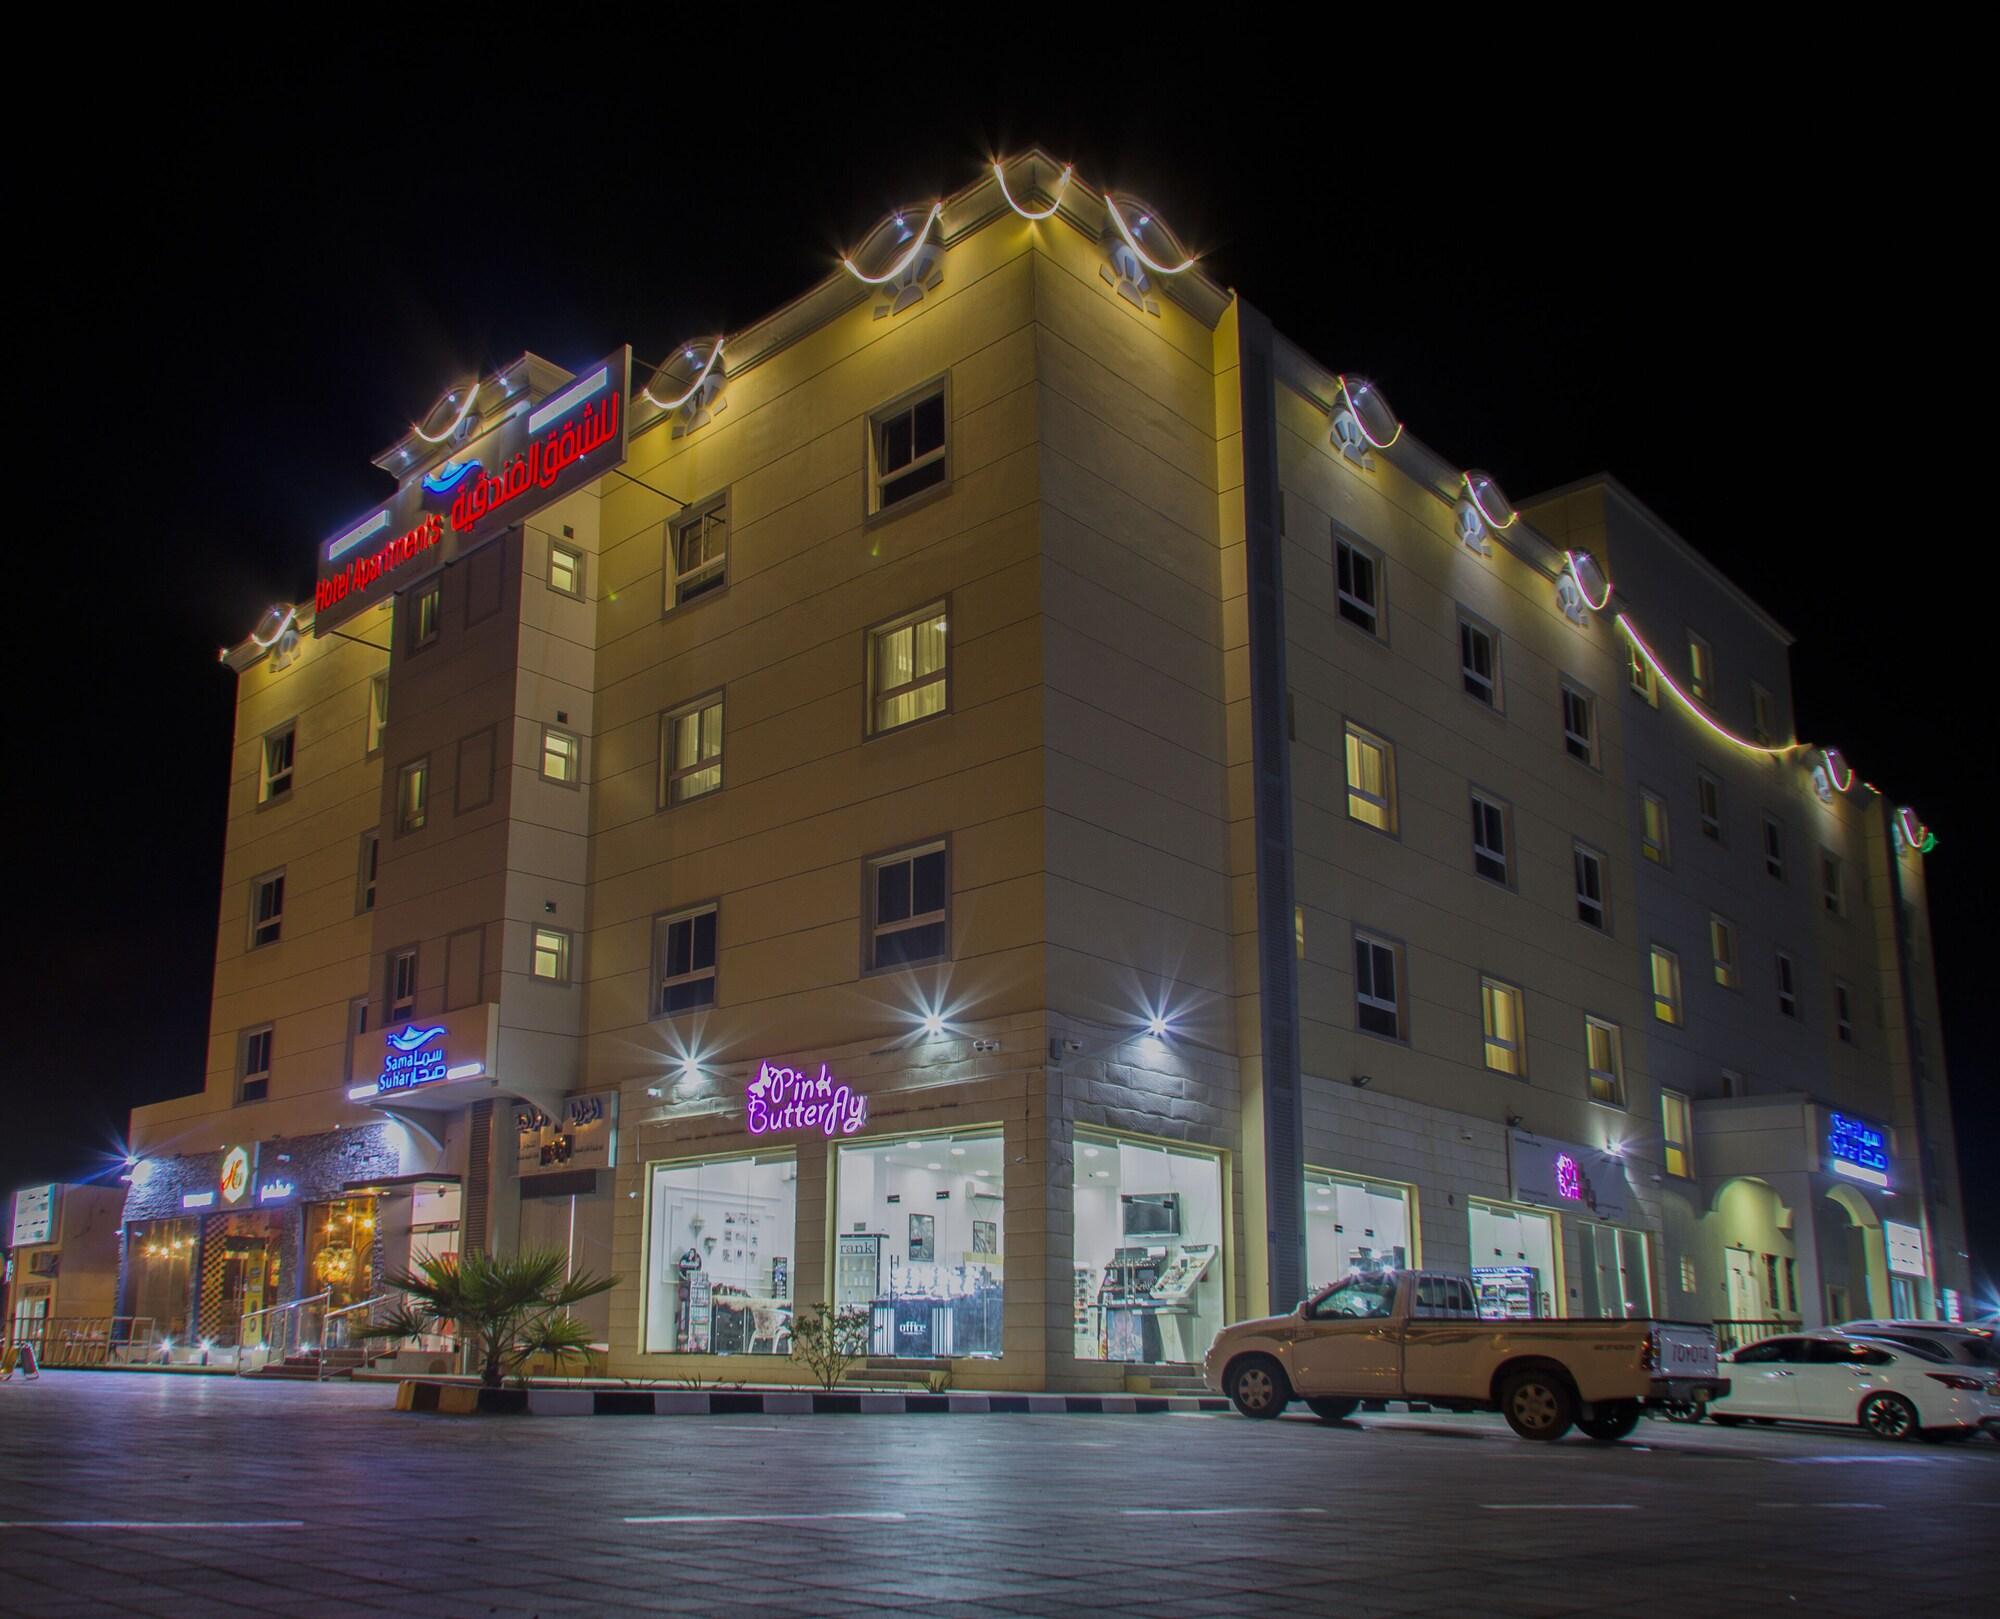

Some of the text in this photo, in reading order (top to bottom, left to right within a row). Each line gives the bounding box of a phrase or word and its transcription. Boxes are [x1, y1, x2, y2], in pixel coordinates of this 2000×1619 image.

[451, 391, 620, 532] للشقق الفندقية
[315, 562, 352, 613] Hotel
[385, 1054, 414, 1073] Sama
[413, 1050, 443, 1067] سما
[379, 1070, 411, 1091] Suhar
[408, 1066, 447, 1088] صحار
[768, 1063, 832, 1103] Pink
[748, 1086, 867, 1135] Butterfly
[840, 1241, 873, 1254] rank
[1672, 1344, 1709, 1362] TOYOTA
